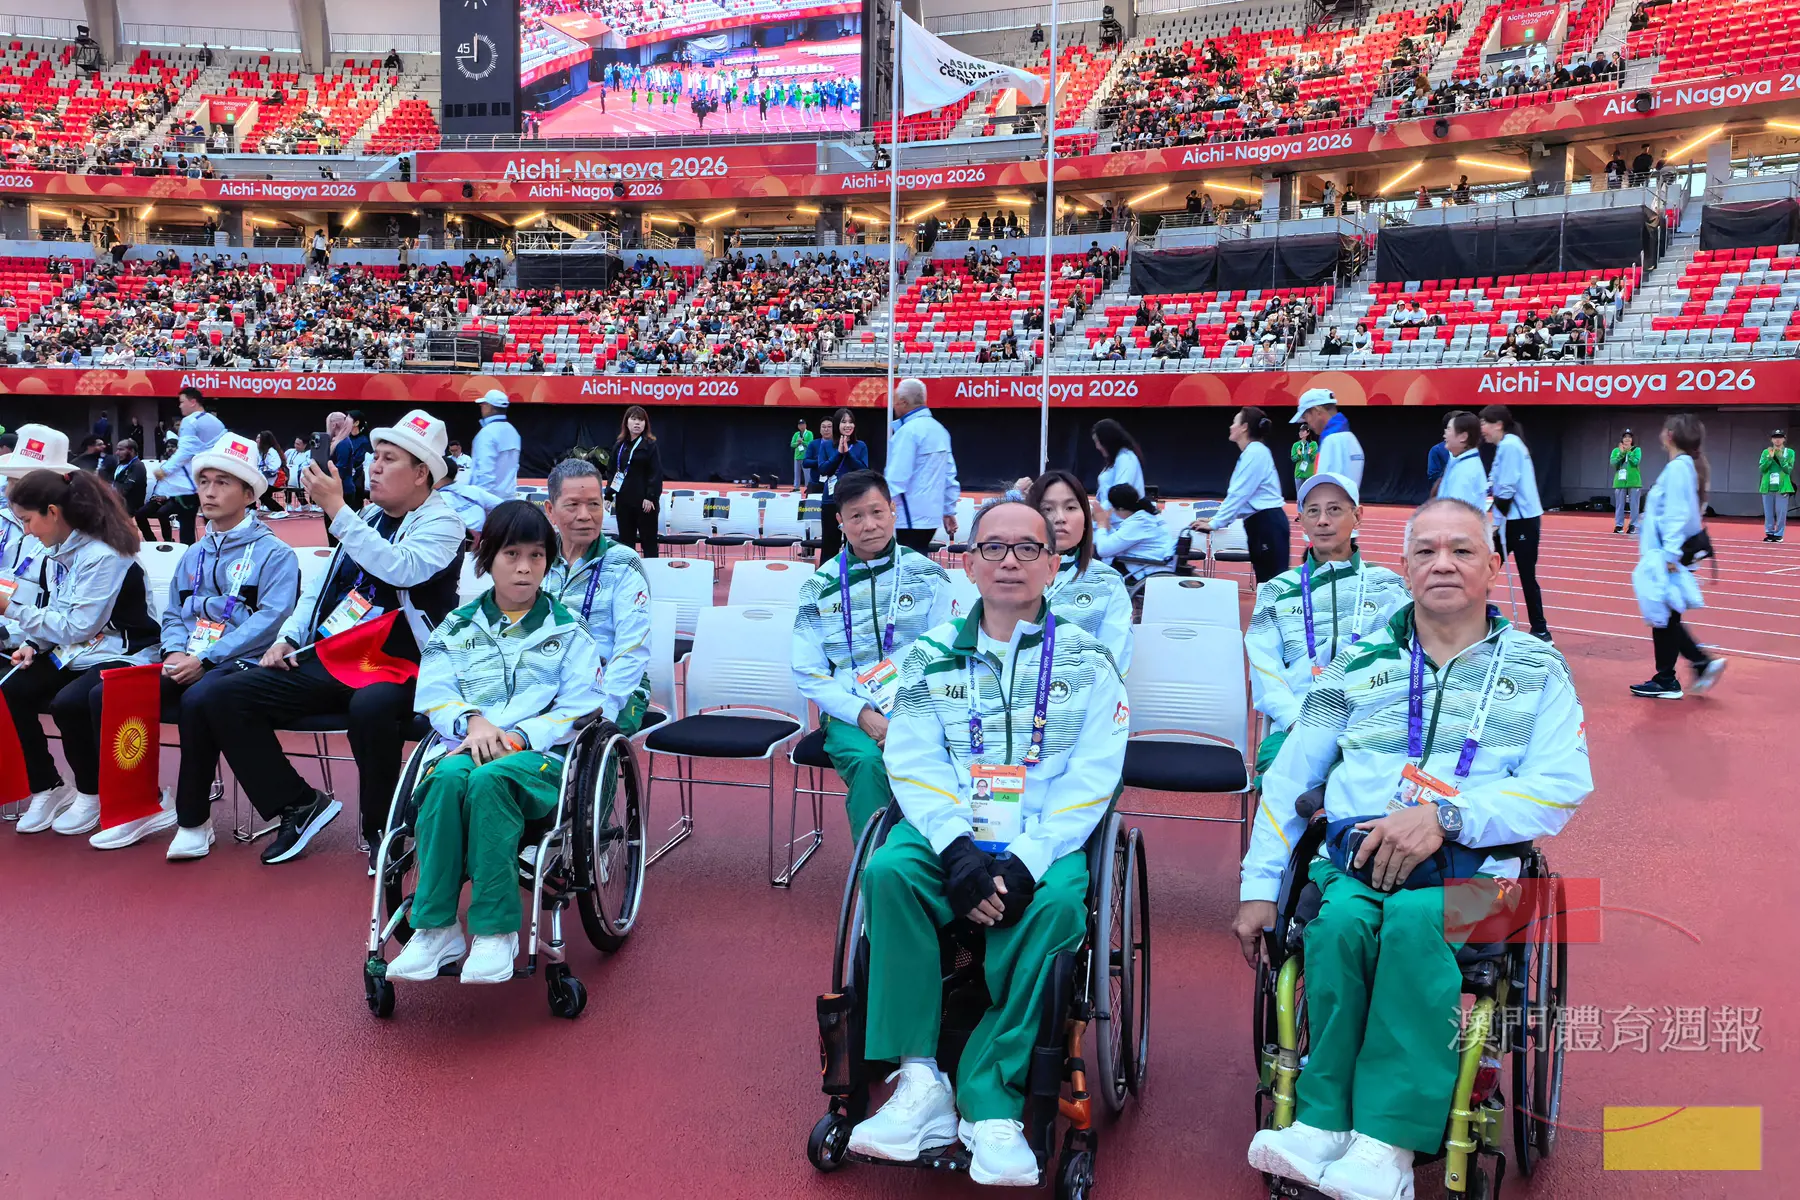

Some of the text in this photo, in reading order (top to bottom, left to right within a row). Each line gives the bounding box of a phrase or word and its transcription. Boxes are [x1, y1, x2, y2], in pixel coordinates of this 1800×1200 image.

[457, 43, 470, 54] 45
[1603, 79, 1772, 117] Aici-Nagoya
[1182, 132, 1353, 164] Aichi-Nagoya 2026
[503, 156, 728, 180] Aichi-Nagoya 2026
[946, 168, 985, 183] 2026
[219, 181, 357, 199] Aichi-Nagoya 2026
[528, 182, 663, 200] Aichi-Nagoy 2026
[179, 373, 337, 394] Aichi-Nagoya 2026
[580, 379, 739, 400] Aichi-Nagoya 2026
[1088, 379, 1139, 397] 2026
[1477, 368, 1756, 398] Aichi-Nagoya 2026
